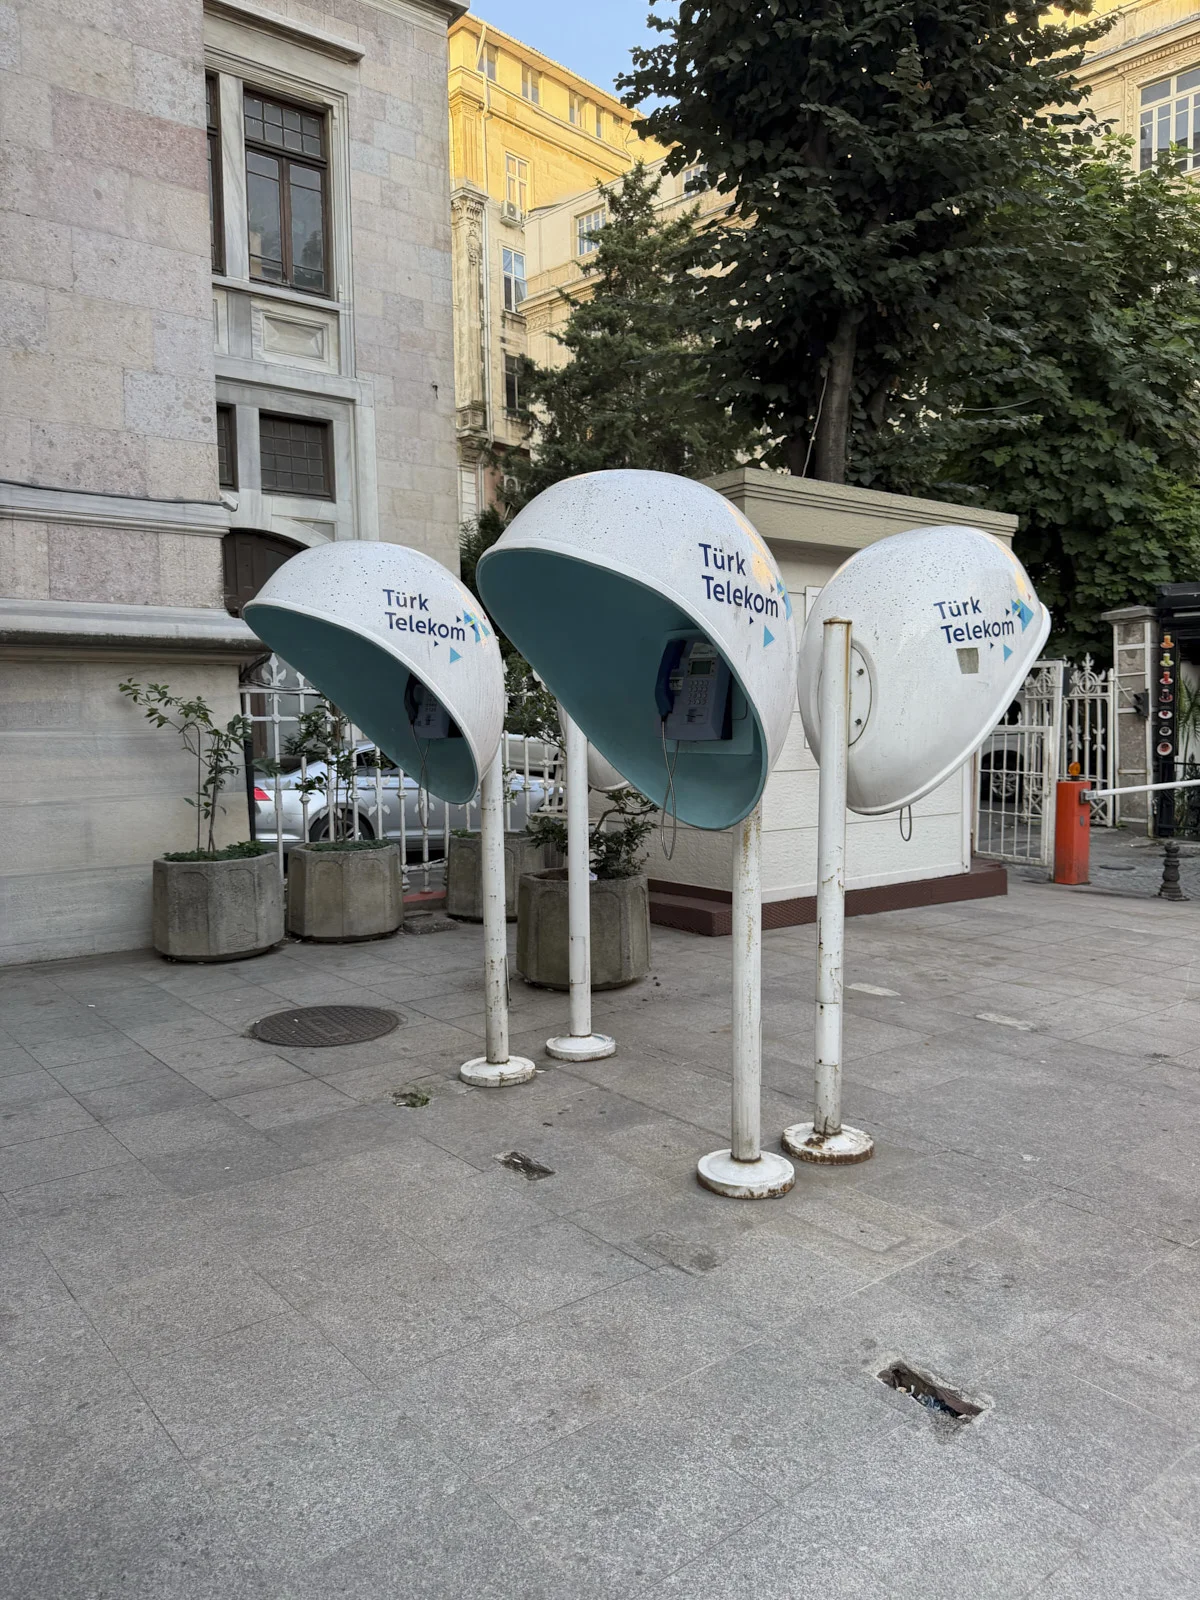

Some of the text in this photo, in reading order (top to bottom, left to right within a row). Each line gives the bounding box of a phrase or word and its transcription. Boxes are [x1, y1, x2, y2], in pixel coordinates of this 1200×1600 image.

[698, 543, 746, 576] Türk
[382, 588, 429, 611] Türk
[701, 575, 778, 618] Telekom
[933, 596, 982, 619] Türk
[384, 612, 466, 641] Telekom
[940, 620, 1014, 644] Telekom
